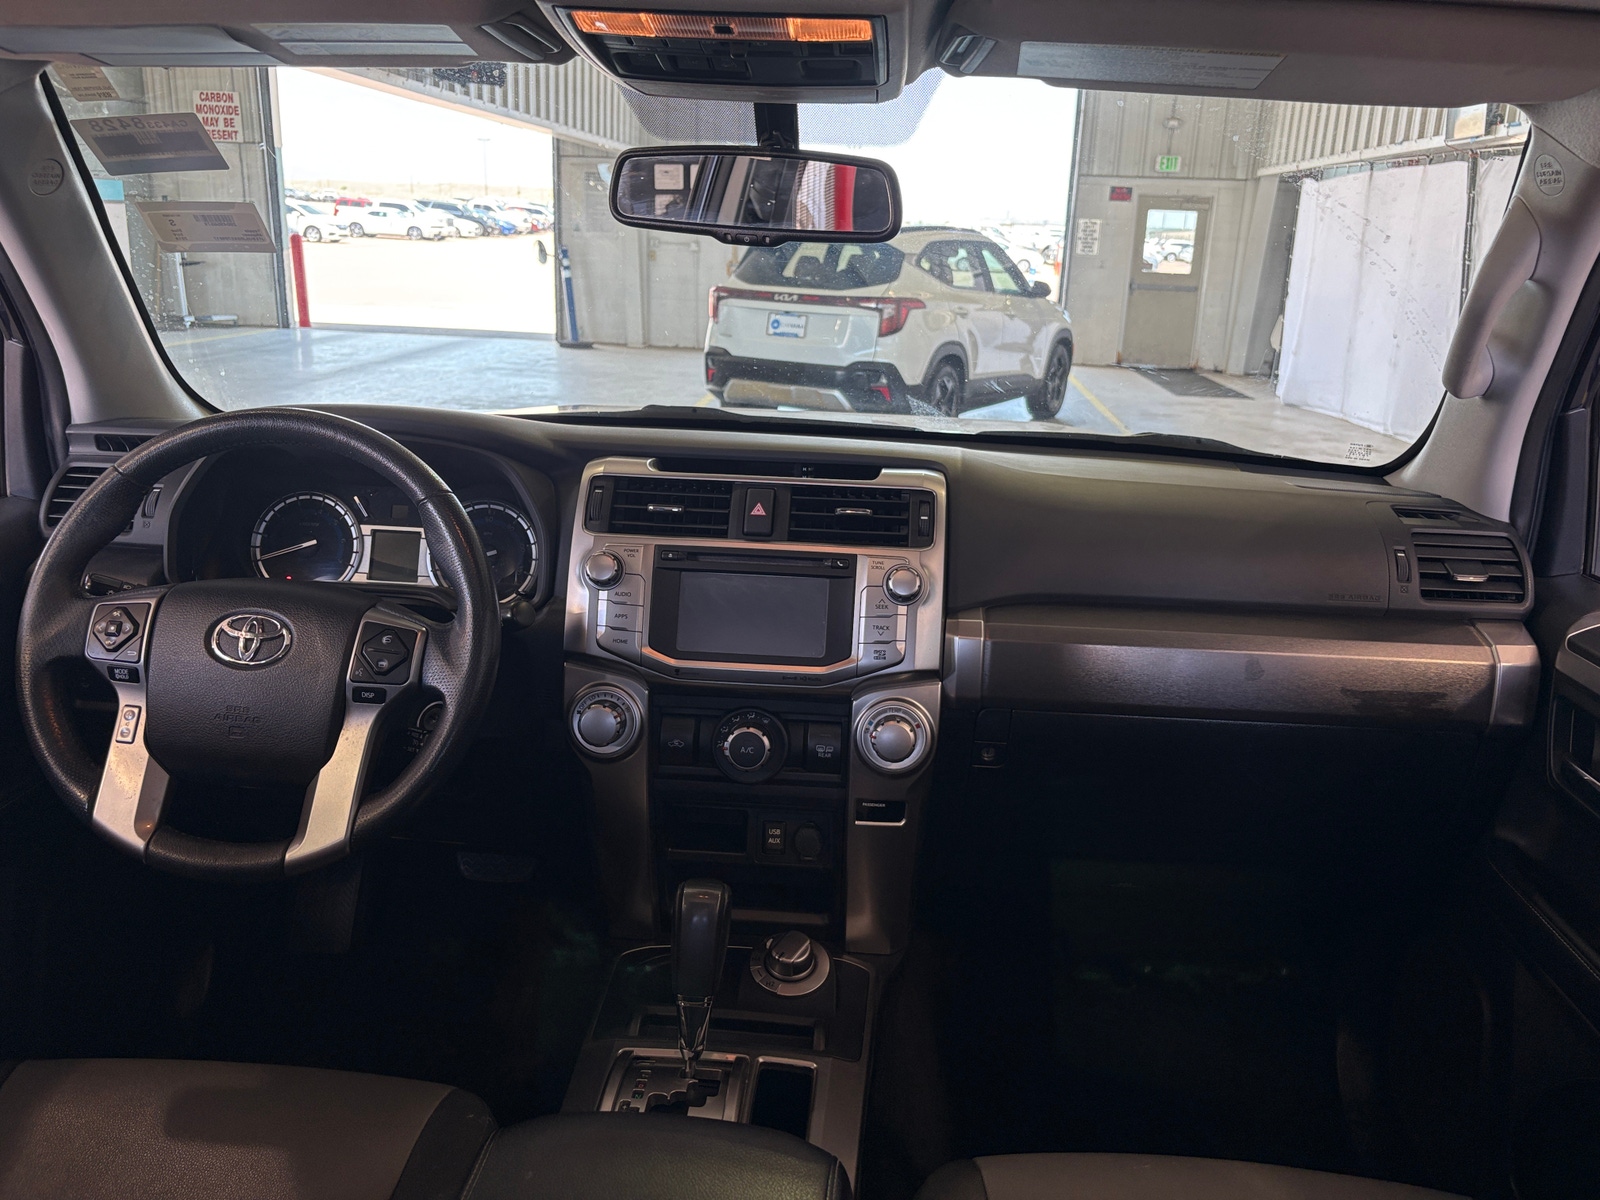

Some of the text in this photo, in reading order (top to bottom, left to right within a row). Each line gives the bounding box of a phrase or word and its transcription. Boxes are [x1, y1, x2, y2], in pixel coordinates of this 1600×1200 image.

[199, 91, 234, 103] CARBON
[195, 103, 240, 116] MONOXIDE
[202, 116, 236, 128] MAY BE
[206, 129, 239, 141] ESENT
[1159, 156, 1179, 171] EXIT
[773, 293, 799, 302] KIA
[740, 746, 755, 755] A/C
